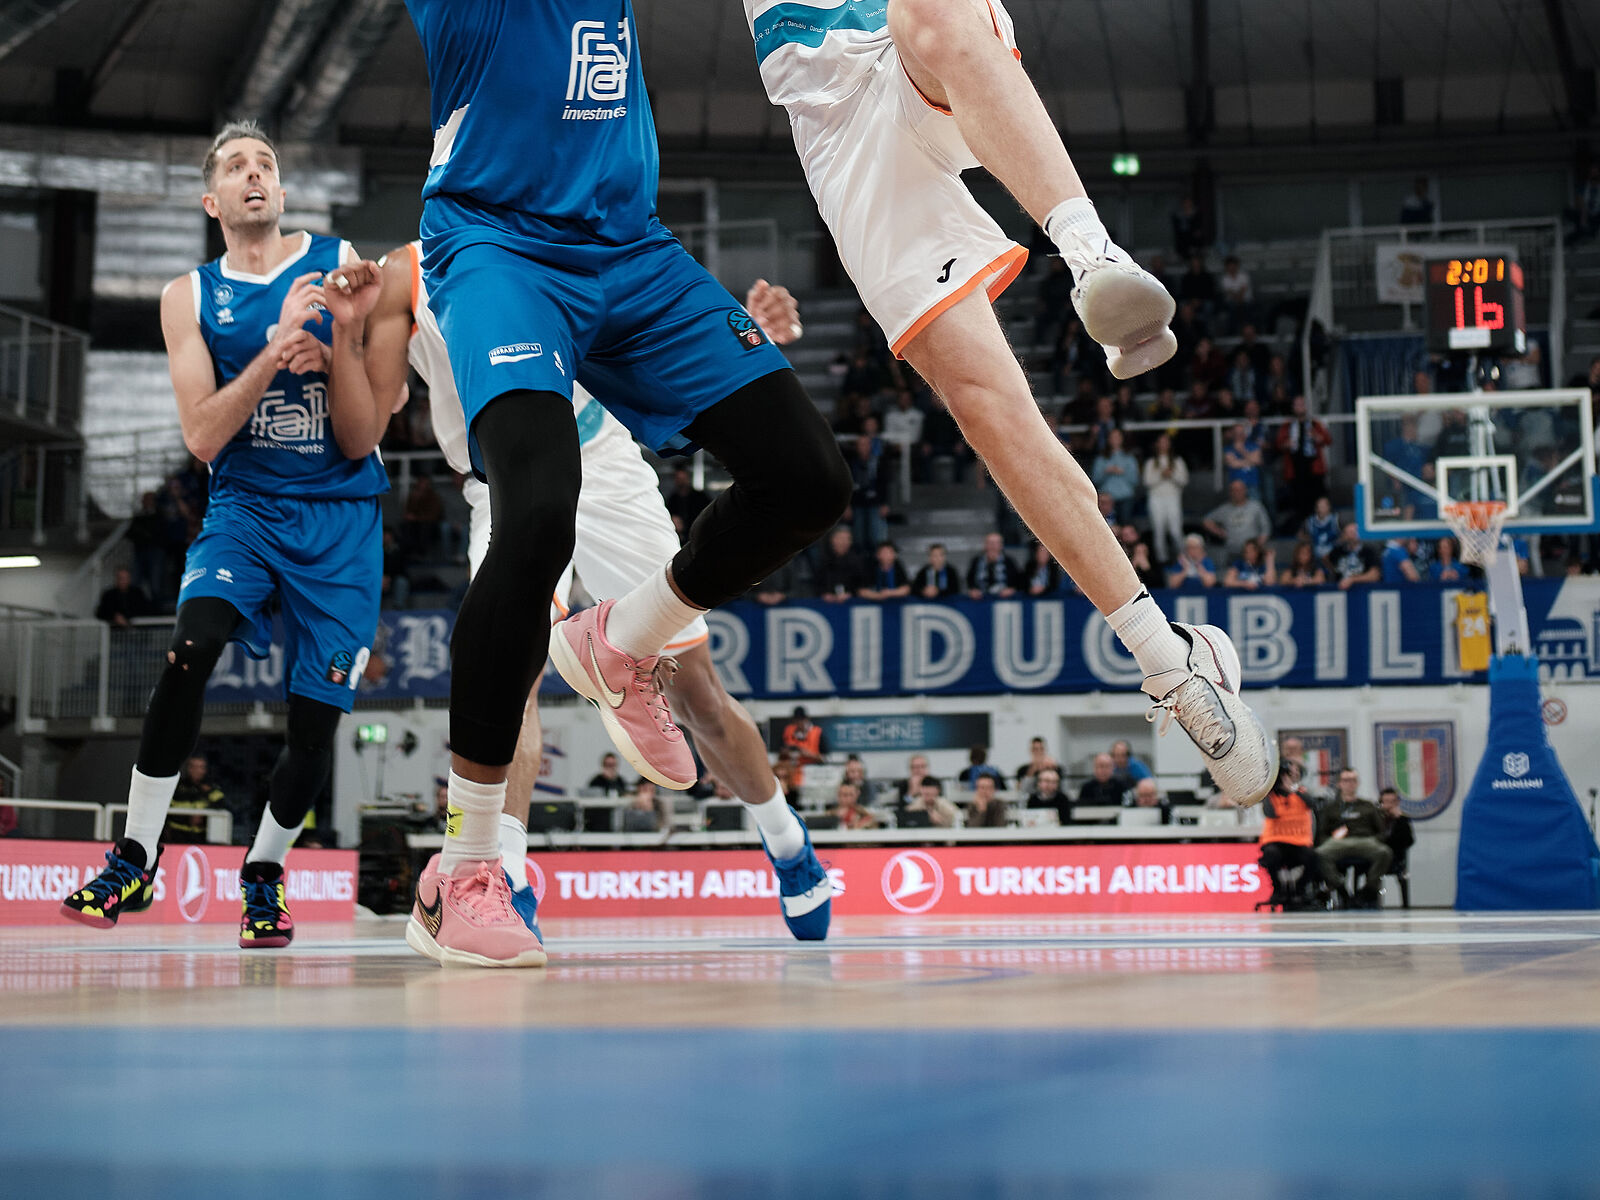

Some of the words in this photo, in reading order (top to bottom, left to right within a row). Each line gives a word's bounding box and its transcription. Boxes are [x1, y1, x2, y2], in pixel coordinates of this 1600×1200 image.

[1446, 258, 1504, 286] 2:01
[1454, 286, 1504, 330] 16
[554, 870, 695, 900] TURKISH
[699, 868, 847, 899] AIRLS
[953, 865, 1101, 896] TURKISH
[1107, 863, 1261, 894] AIRLINES
